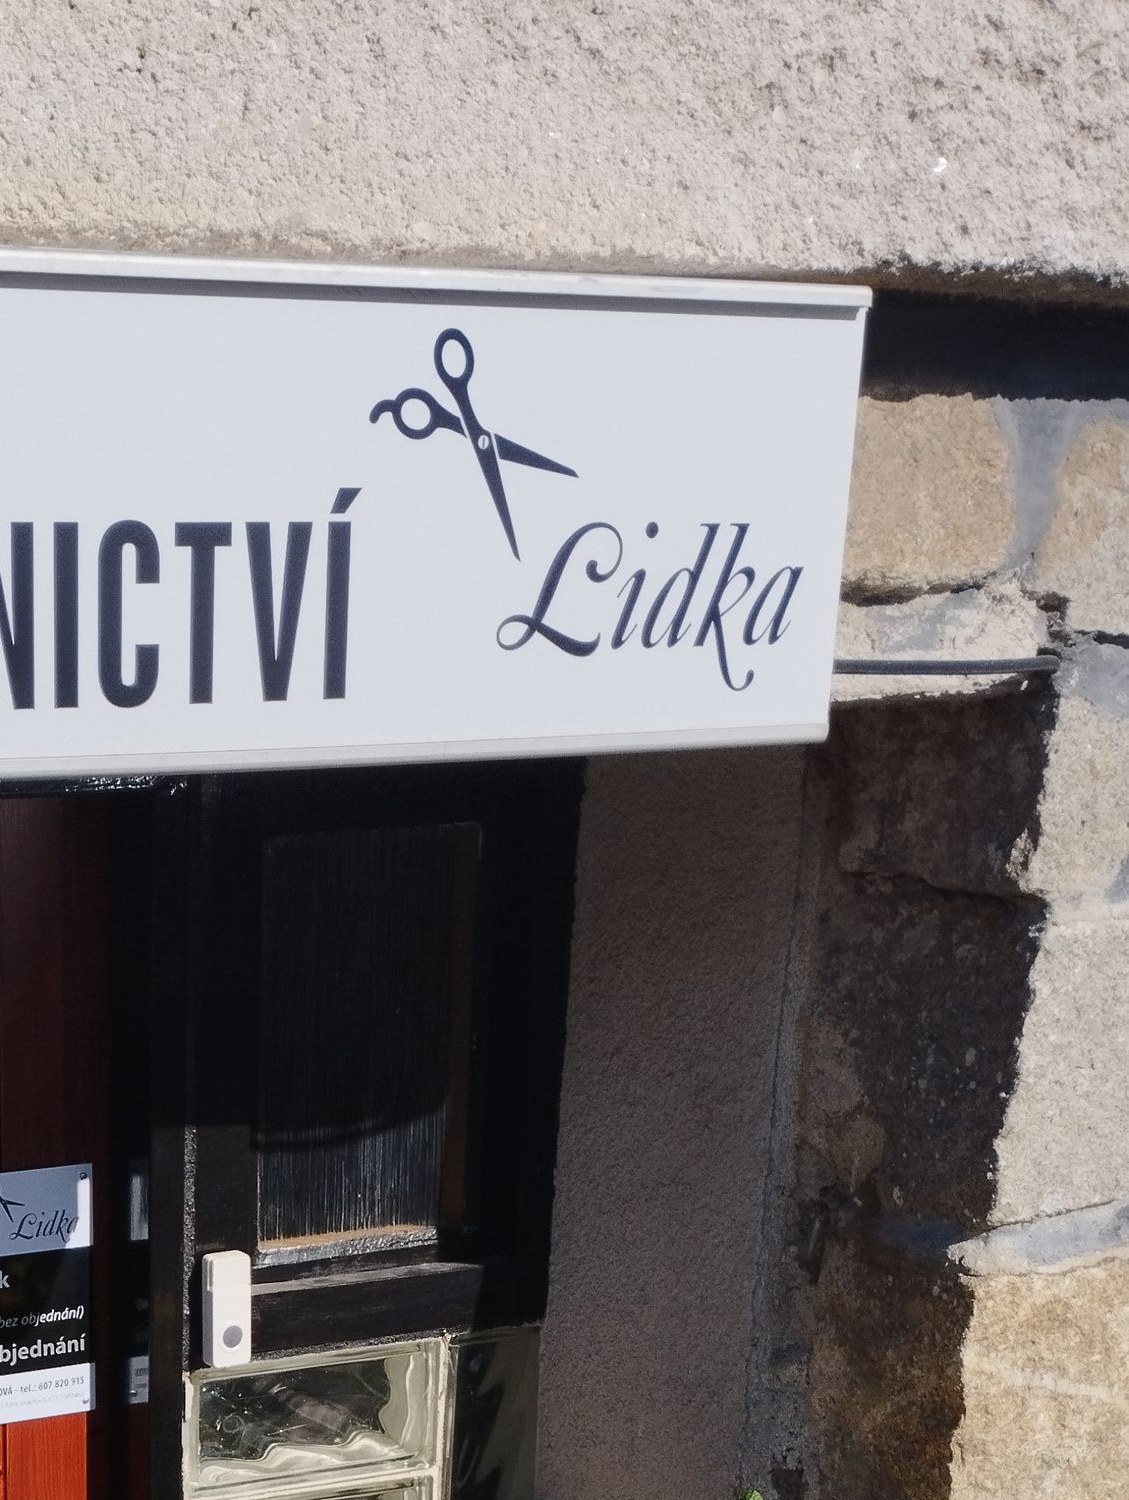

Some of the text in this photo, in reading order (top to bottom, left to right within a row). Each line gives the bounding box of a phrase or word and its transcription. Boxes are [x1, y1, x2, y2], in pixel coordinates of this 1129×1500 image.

[496, 521, 804, 692] Lidka
[21, 1304, 85, 1327] objednání)
[38, 1380, 53, 1391] 607
[71, 1376, 85, 1386] 915
